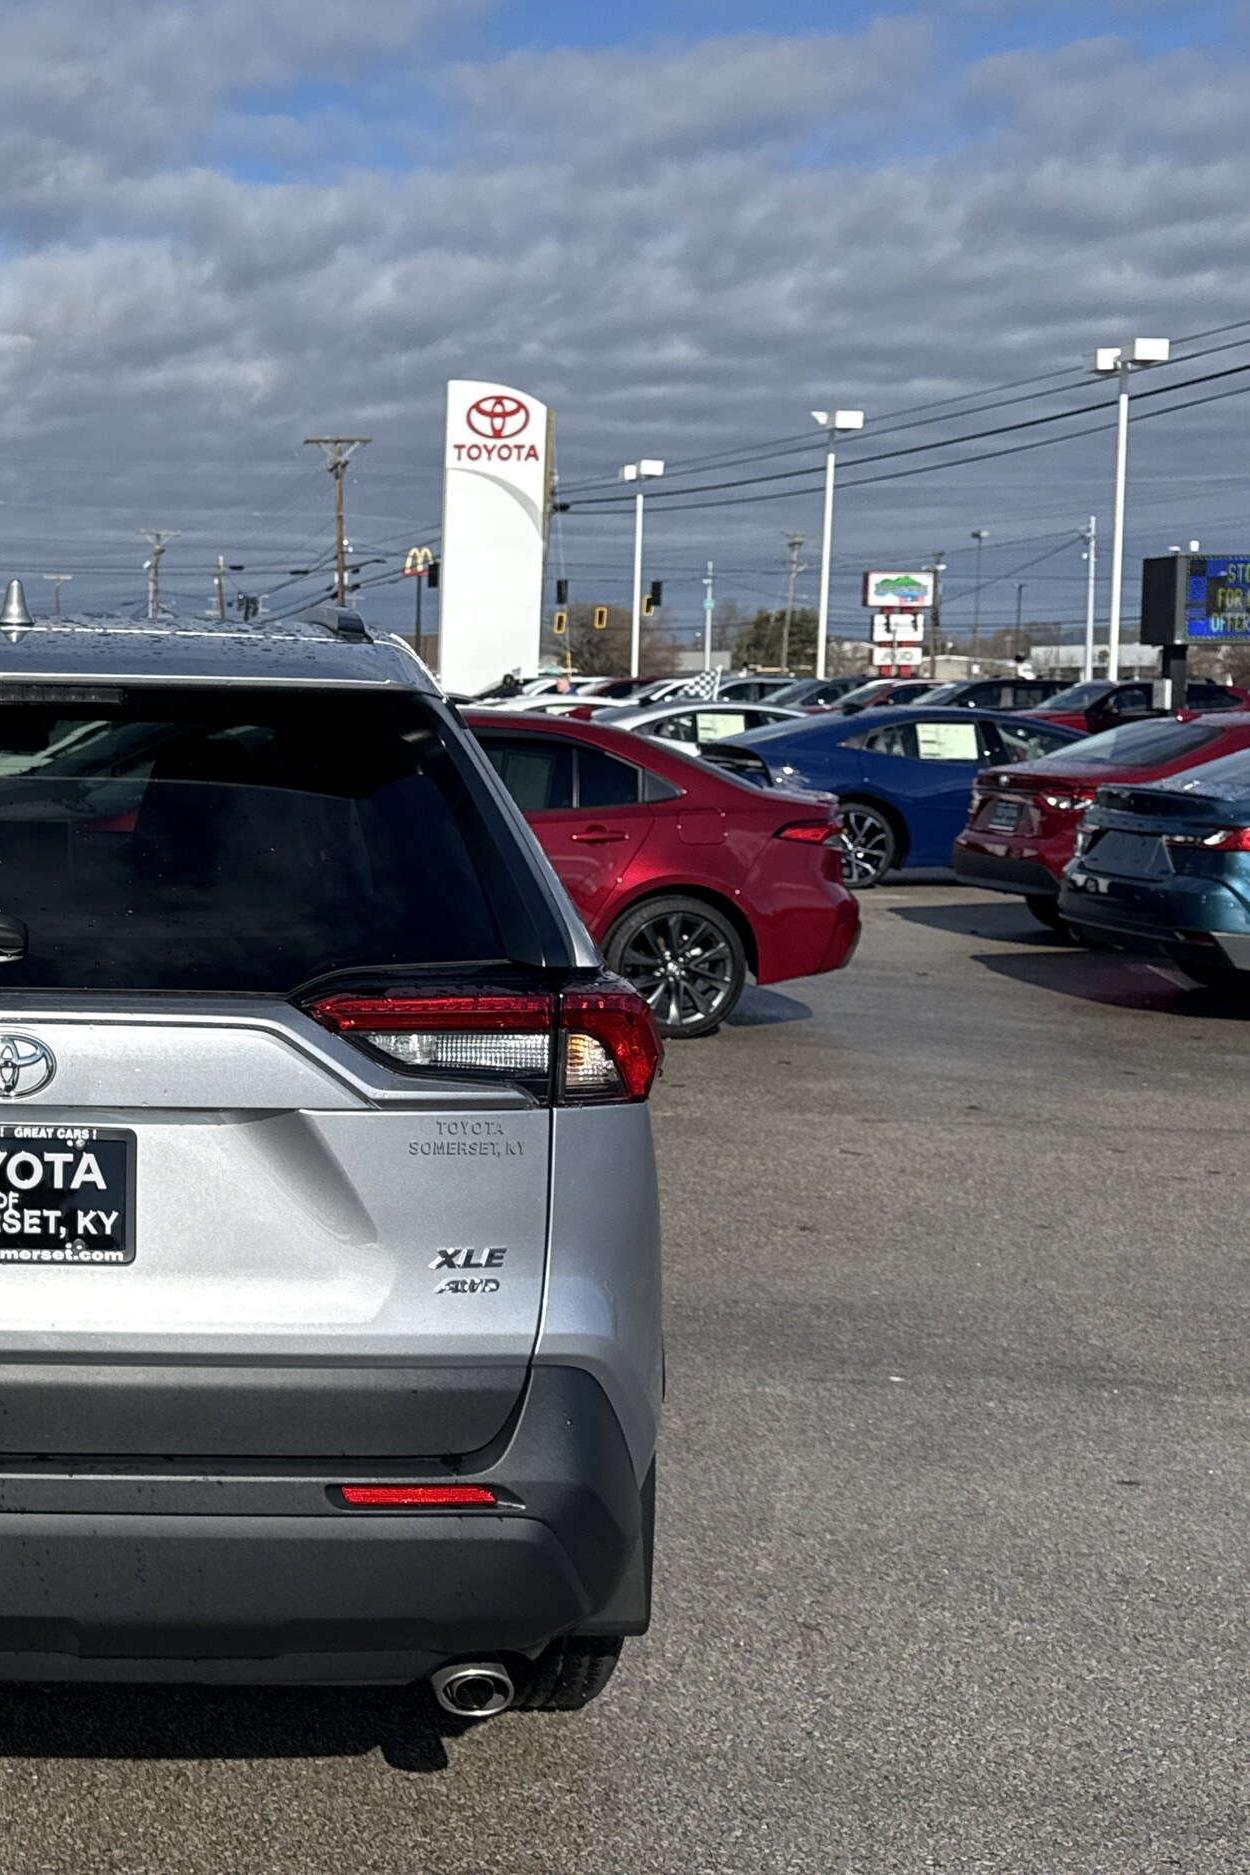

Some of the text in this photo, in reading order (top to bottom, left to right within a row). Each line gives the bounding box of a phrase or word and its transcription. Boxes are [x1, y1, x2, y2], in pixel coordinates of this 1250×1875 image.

[453, 443, 540, 462] TOYOTA
[14, 1127, 54, 1139] GREAT
[436, 1121, 505, 1136] TOYOTA
[408, 1141, 525, 1157] SOMERSET, KY
[77, 1210, 119, 1235] KY
[429, 1246, 507, 1270] XLE
[435, 1279, 500, 1294] AWD
